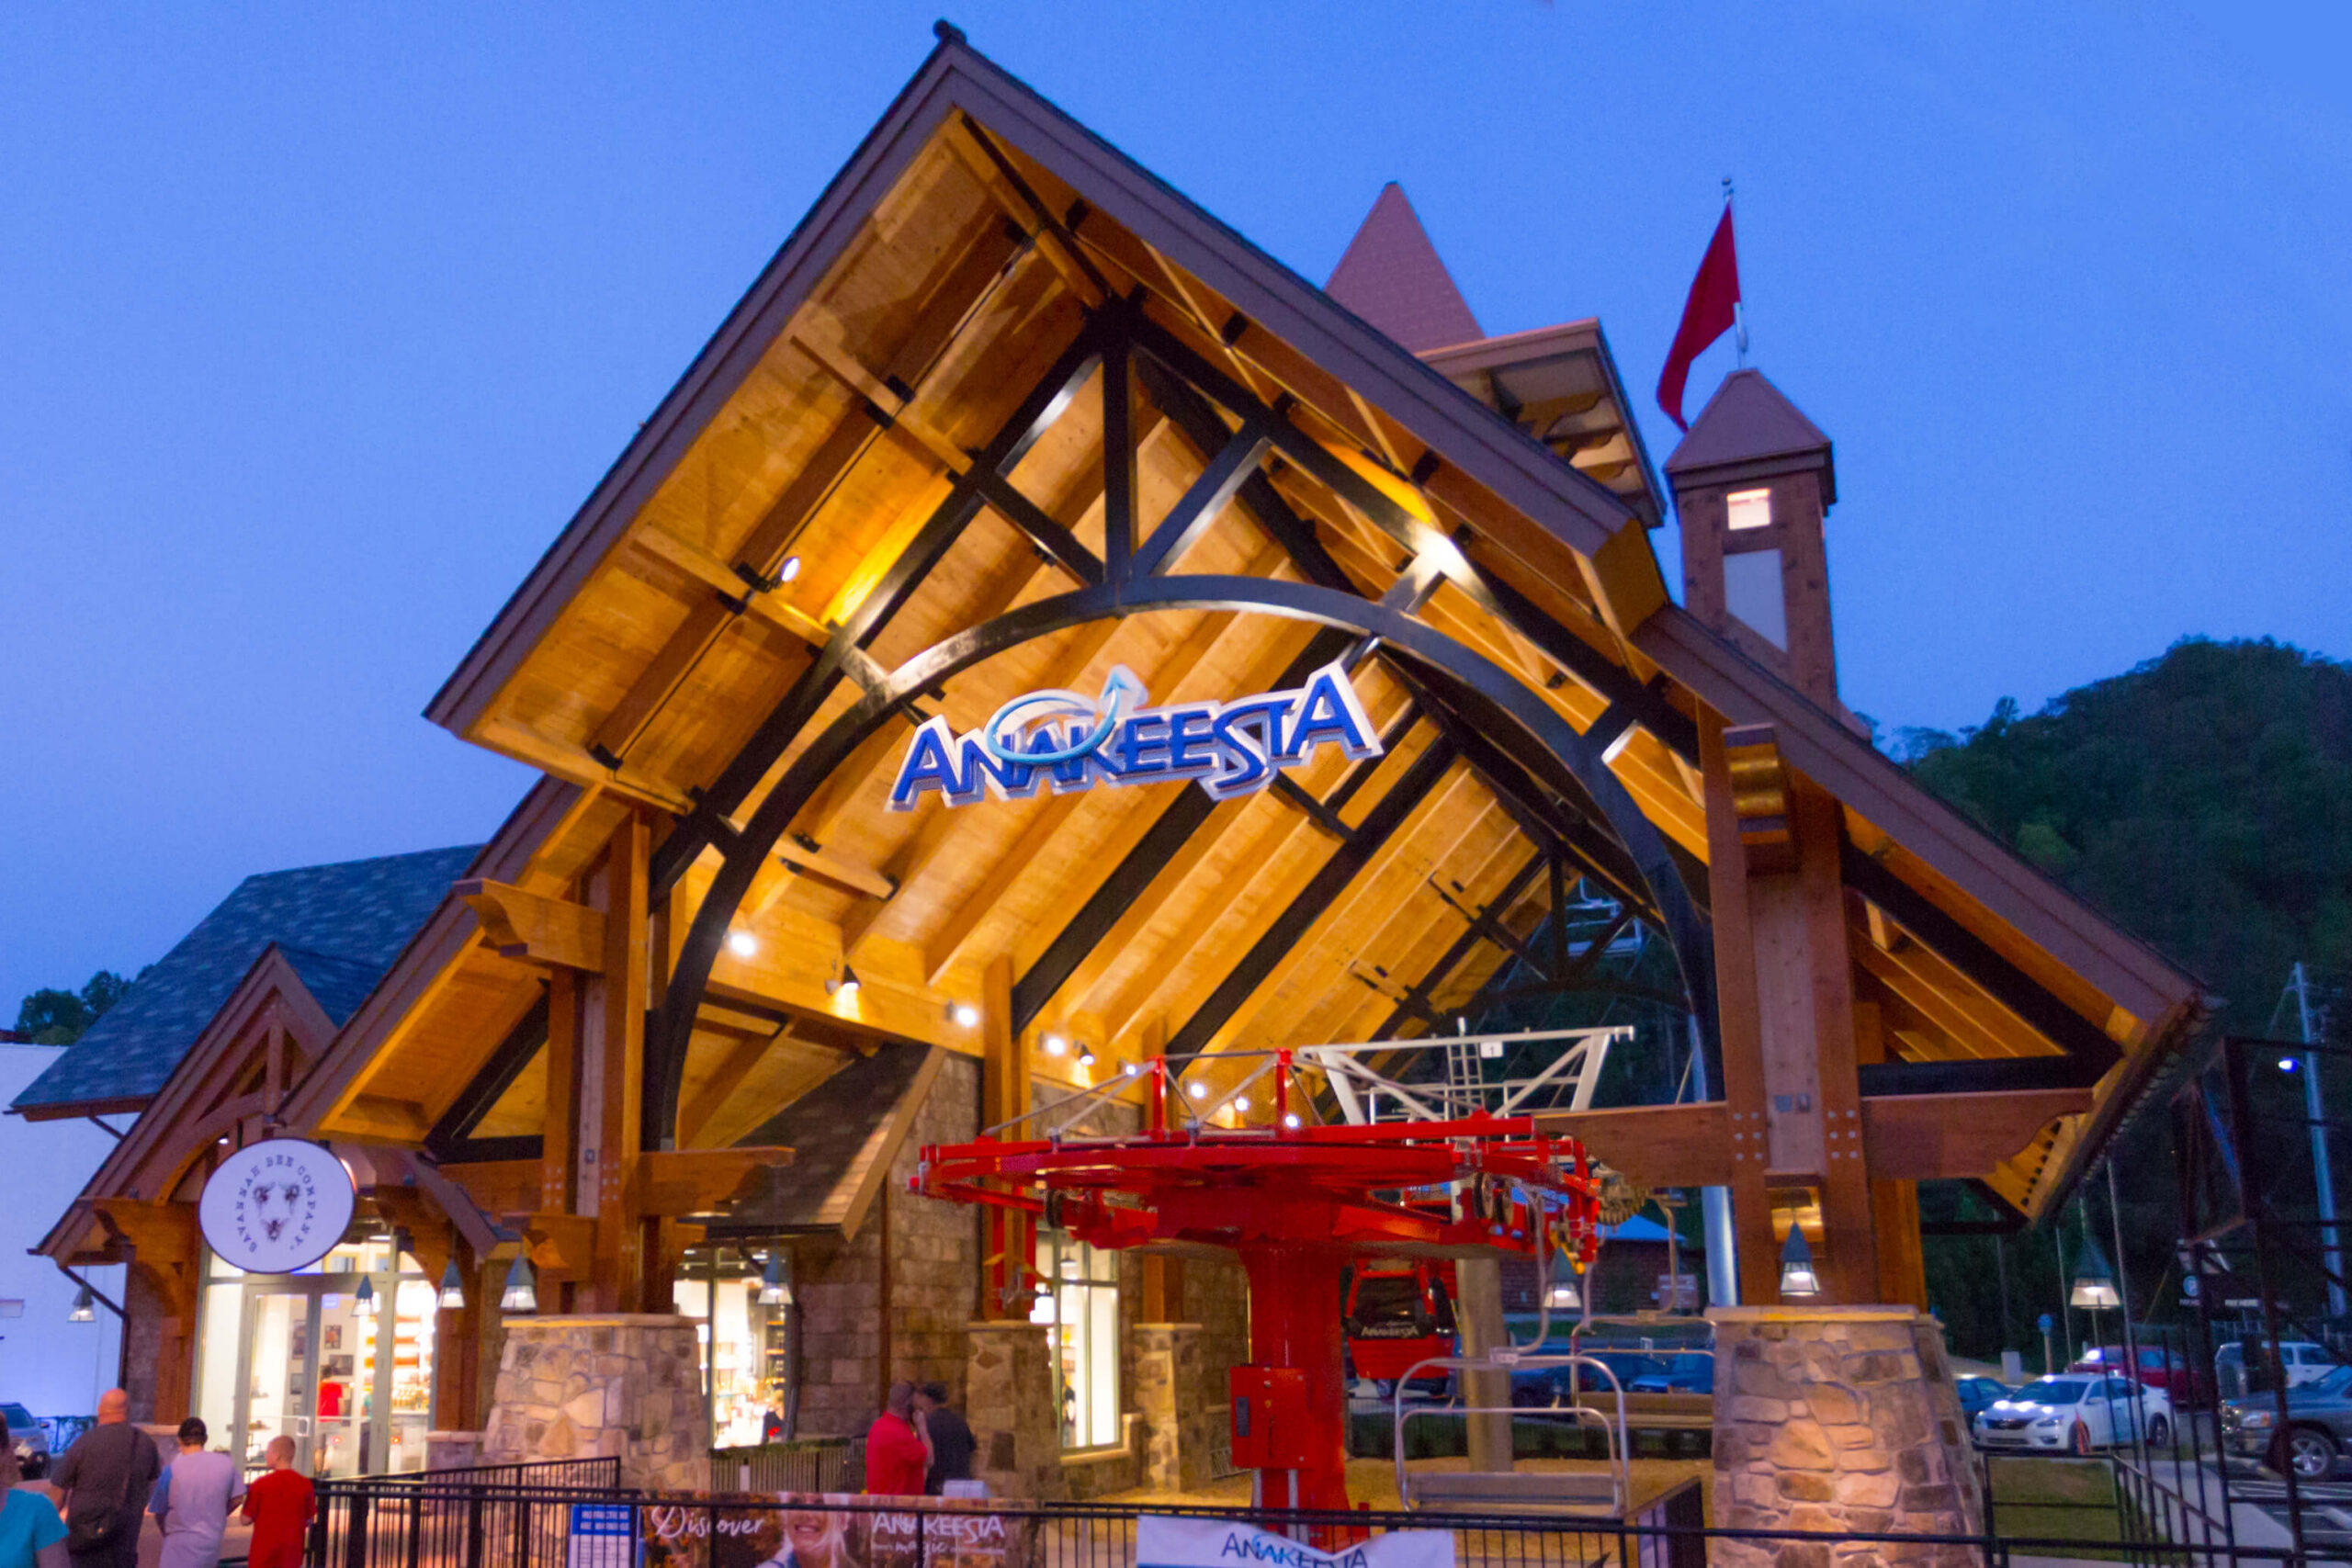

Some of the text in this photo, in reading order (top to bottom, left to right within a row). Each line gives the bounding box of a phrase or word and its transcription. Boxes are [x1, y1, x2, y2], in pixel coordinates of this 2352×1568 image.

[886, 663, 1382, 810] ANAKEESTA
[236, 1165, 261, 1253] SAVANNAH
[266, 1155, 294, 1168] BEE
